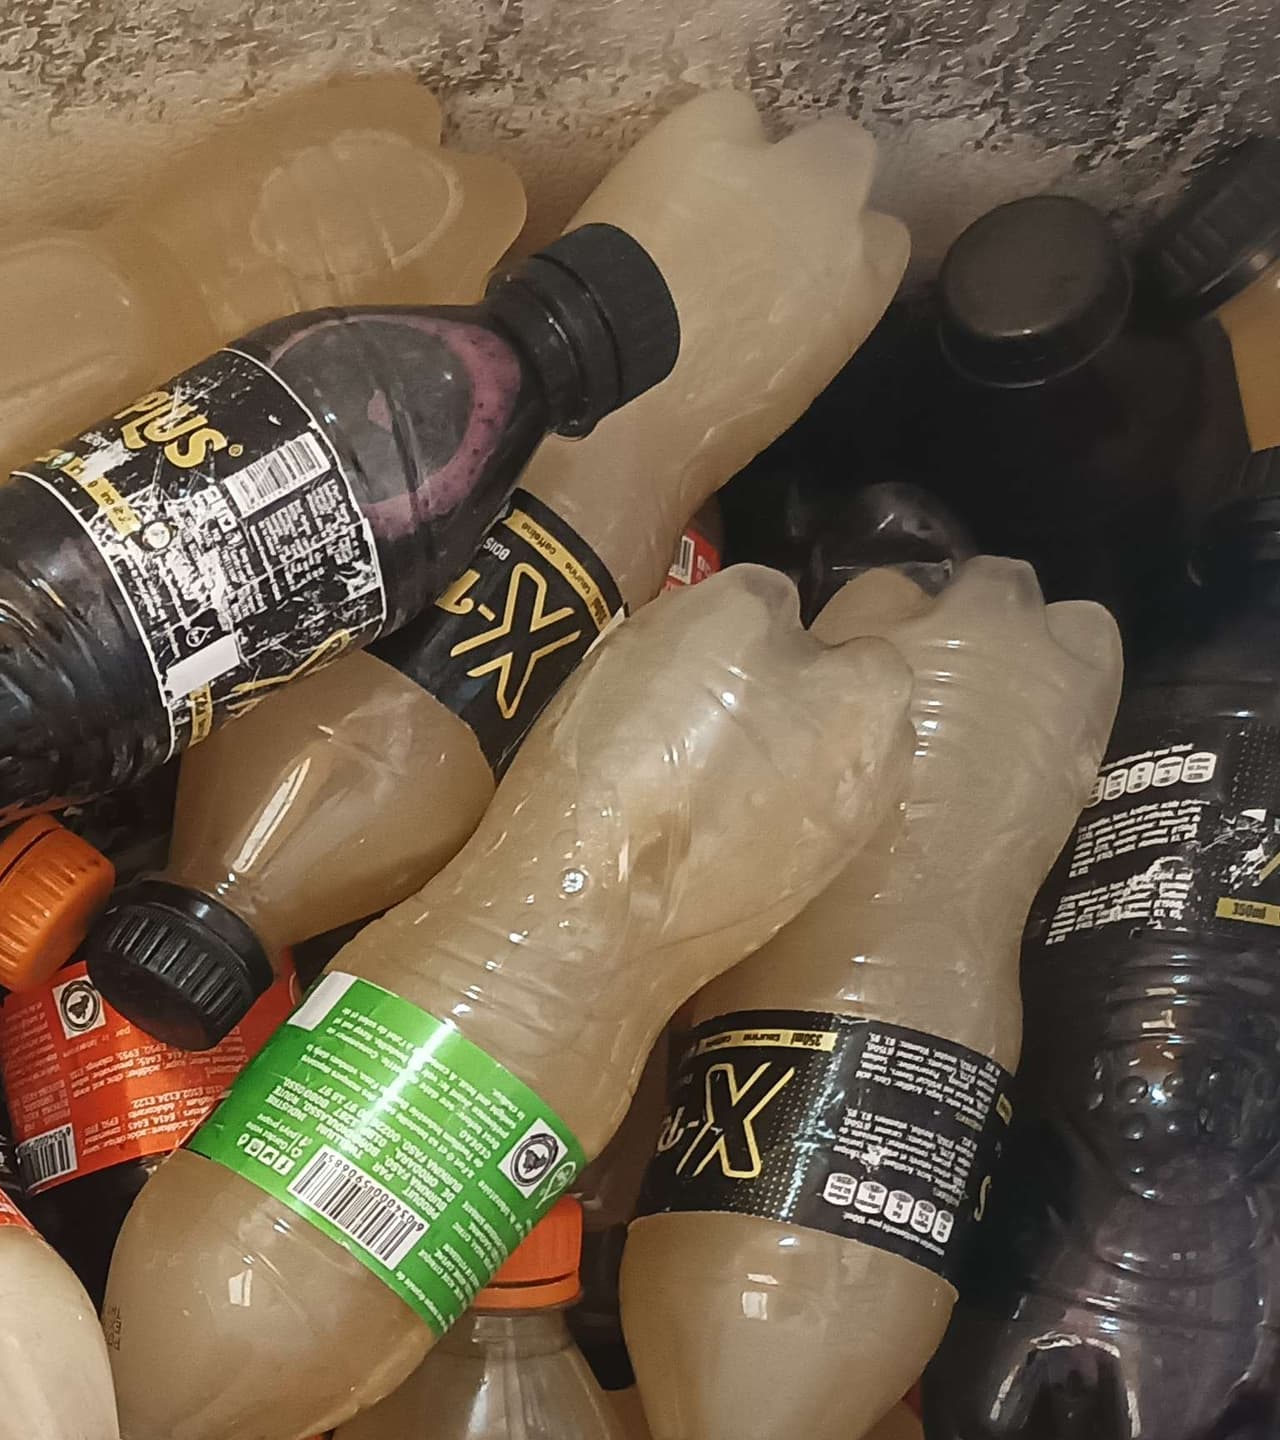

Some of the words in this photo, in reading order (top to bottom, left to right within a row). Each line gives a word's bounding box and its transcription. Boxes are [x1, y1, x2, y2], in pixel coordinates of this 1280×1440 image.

[112, 389, 228, 471] PLUS
[483, 532, 512, 562] BOIS
[273, 1083, 299, 1106] ROUTE
[324, 1152, 372, 1190] 590685
[371, 1160, 394, 1181] PAR
[422, 1158, 464, 1192] BURKINA
[370, 1185, 417, 1224] 034000
[399, 1186, 441, 1220] PRODUIT
[406, 1176, 448, 1211] BURKINA
